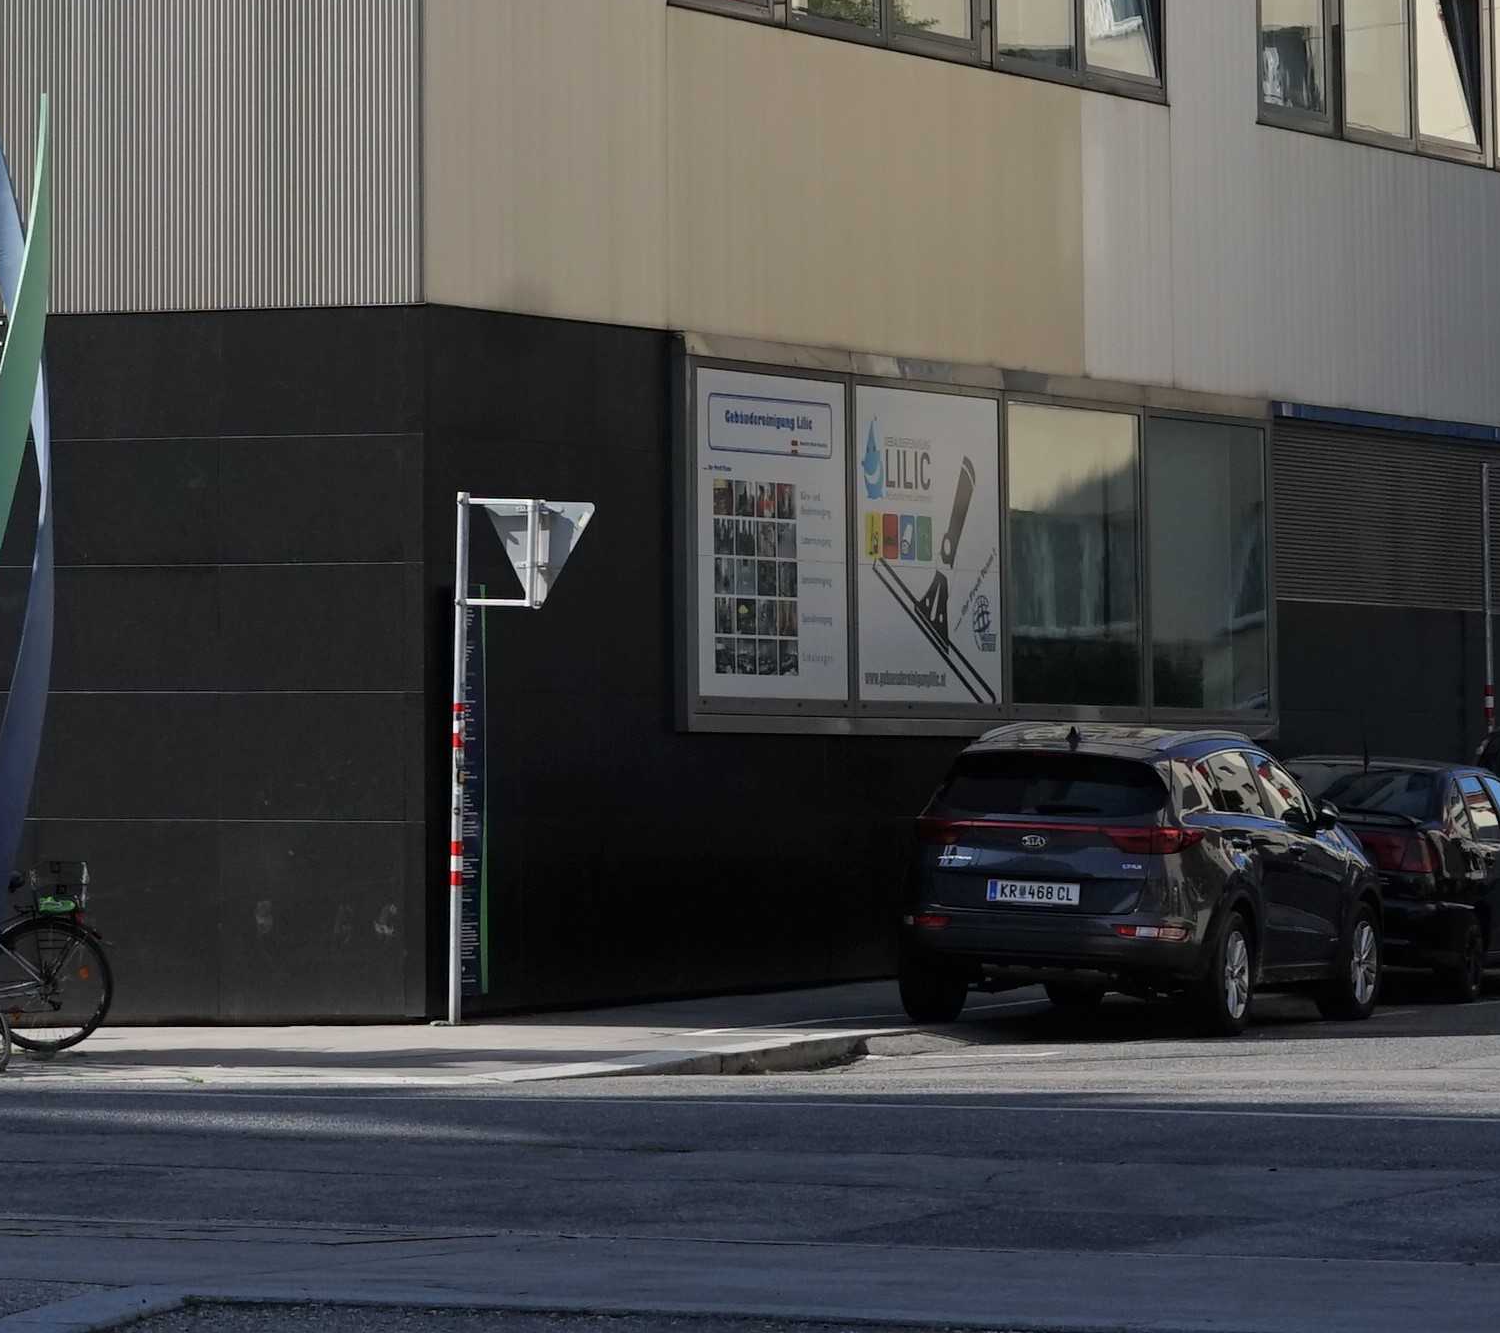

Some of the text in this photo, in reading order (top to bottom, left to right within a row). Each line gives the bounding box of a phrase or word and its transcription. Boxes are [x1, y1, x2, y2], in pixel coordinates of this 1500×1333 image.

[724, 409, 795, 431] Gebäudereinigung
[885, 449, 932, 490] LILIC
[999, 884, 1073, 901] KR 468 CL
